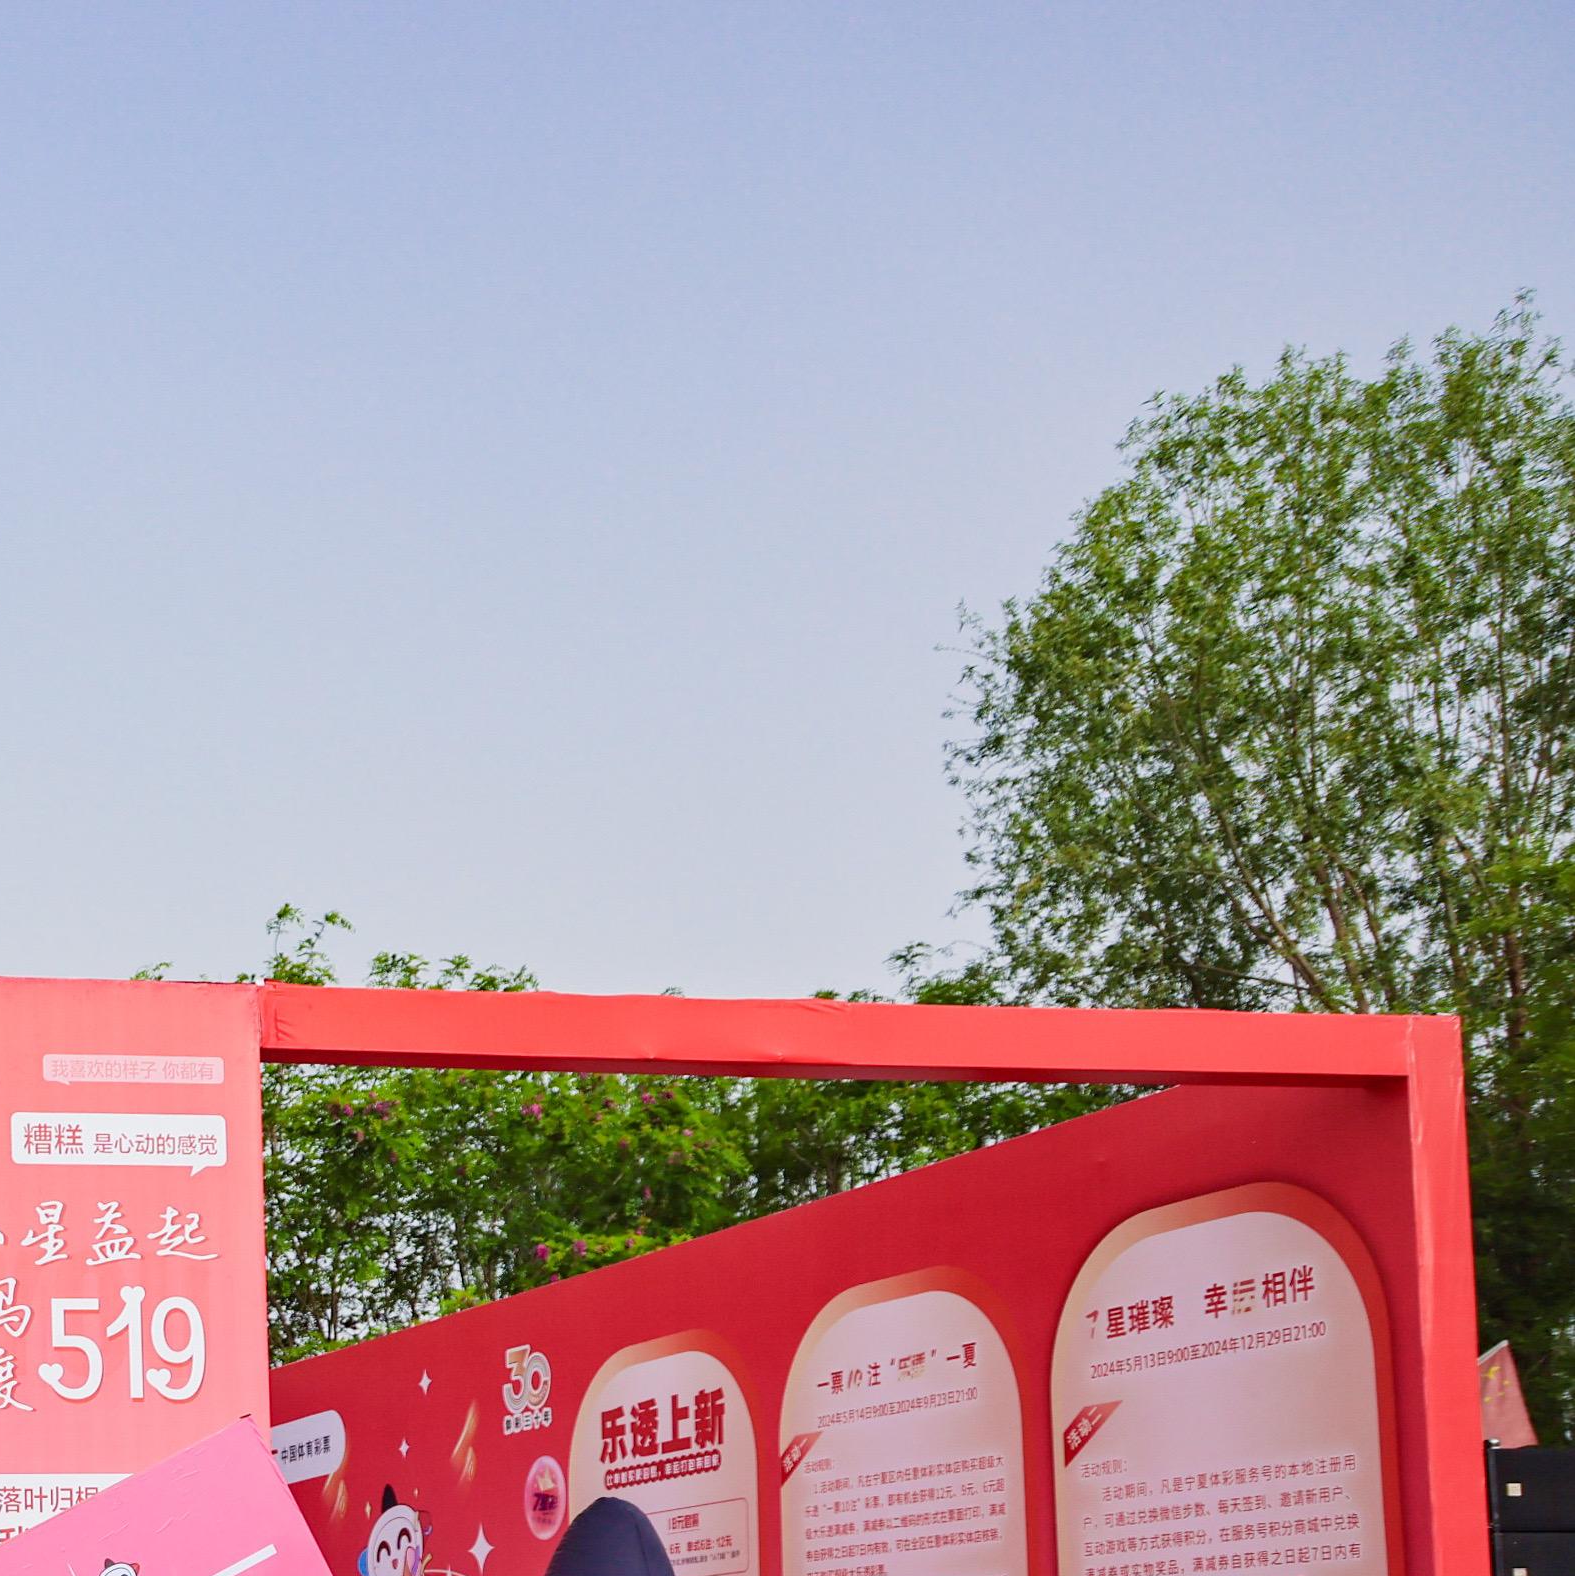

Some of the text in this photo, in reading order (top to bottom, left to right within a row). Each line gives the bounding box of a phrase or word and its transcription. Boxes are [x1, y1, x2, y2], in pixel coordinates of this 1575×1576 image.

[50, 1058, 215, 1081] 我喜欢的样子 你都有
[23, 1123, 219, 1157] 糟糕 是心动的感觉
[38, 1285, 207, 1402] 519
[600, 1387, 725, 1463] 乐透上新
[1066, 1406, 1103, 1450] 活动二
[281, 1434, 331, 1464] 中国体育彩票
